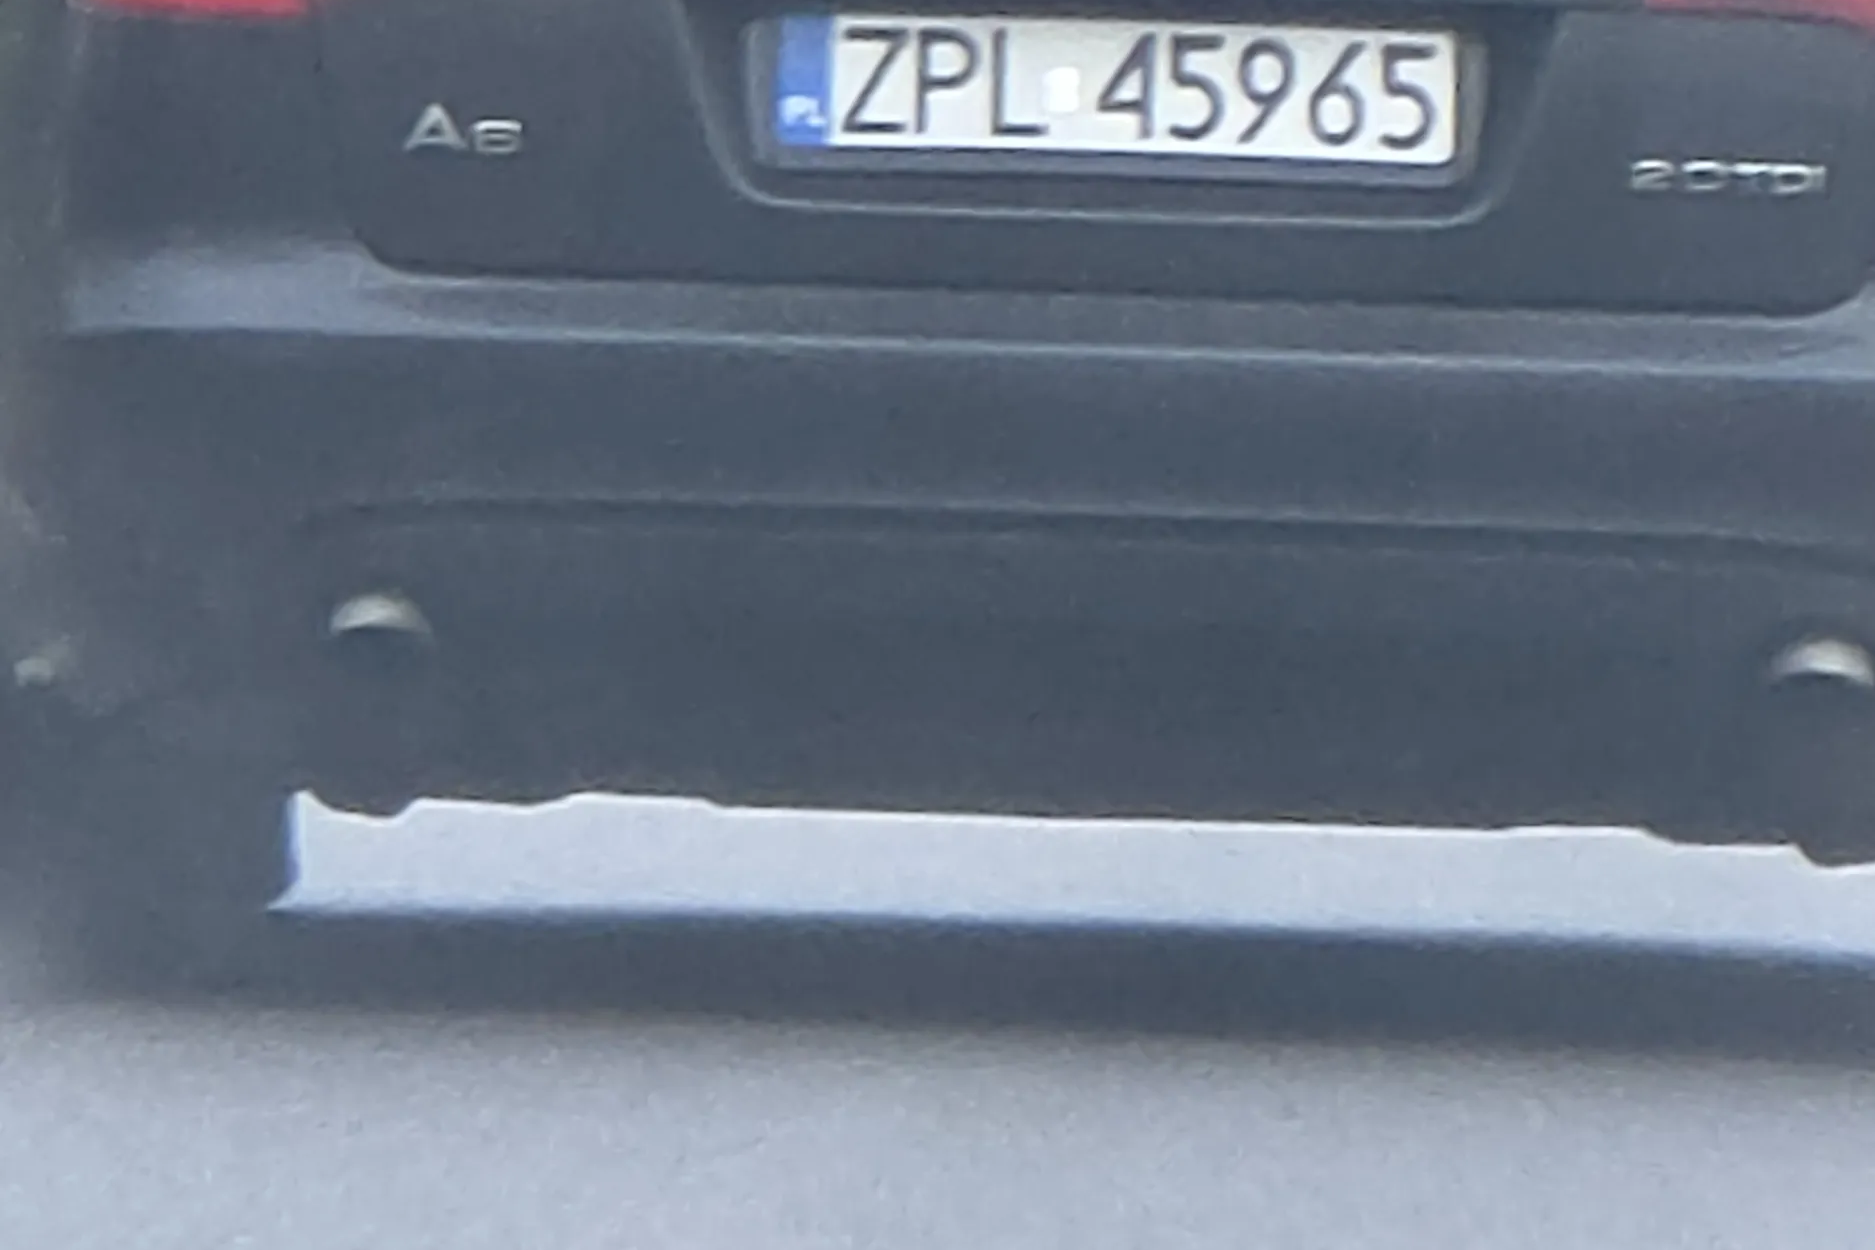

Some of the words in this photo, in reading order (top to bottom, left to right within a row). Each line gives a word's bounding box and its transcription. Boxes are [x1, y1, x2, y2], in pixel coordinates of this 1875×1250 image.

[780, 95, 826, 127] PL
[841, 27, 1049, 137] ZPL
[1095, 31, 1438, 150] 45965
[403, 102, 523, 155] A6
